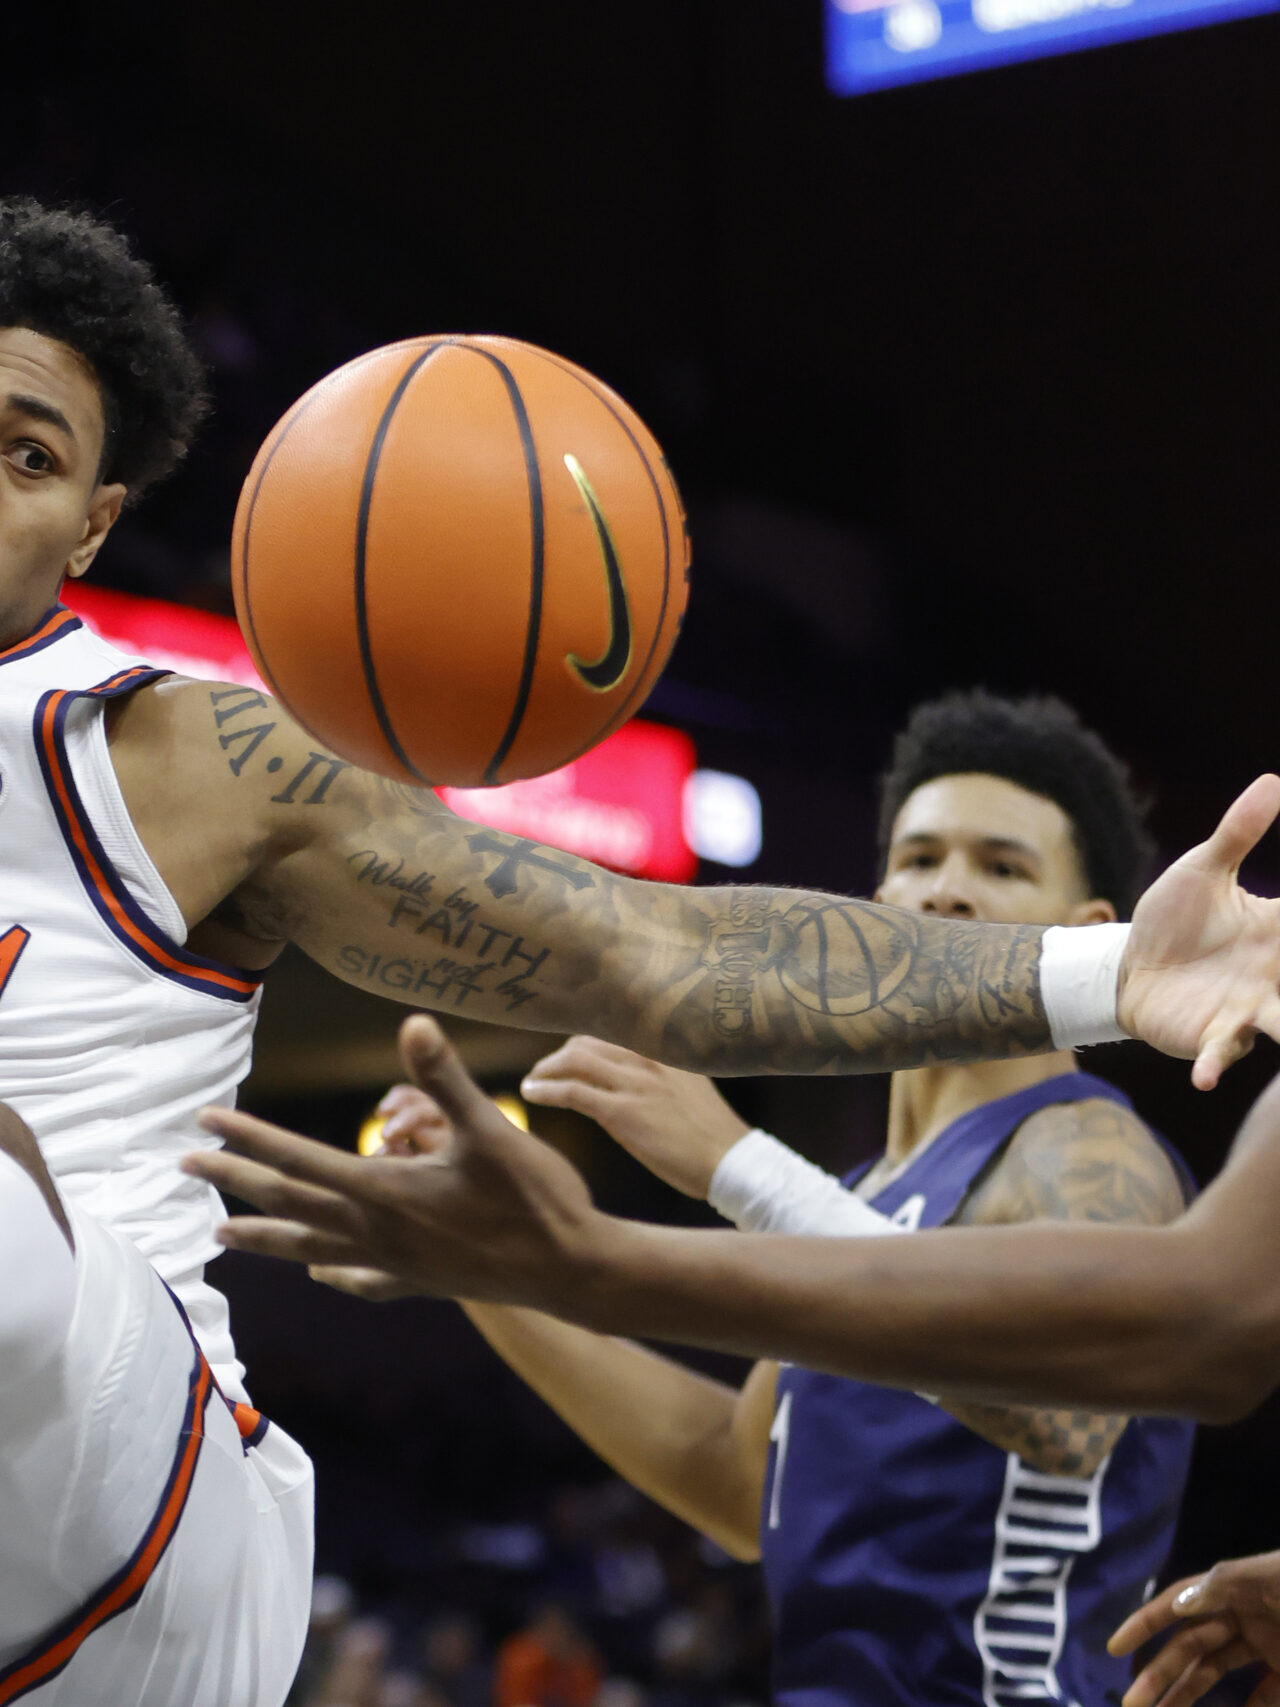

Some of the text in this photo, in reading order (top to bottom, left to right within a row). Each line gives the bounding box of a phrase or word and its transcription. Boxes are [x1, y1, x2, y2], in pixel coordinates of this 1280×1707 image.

[348, 850, 479, 921] Walk by
[388, 895, 552, 976] FAITH
[336, 945, 484, 1006] SIGHT
